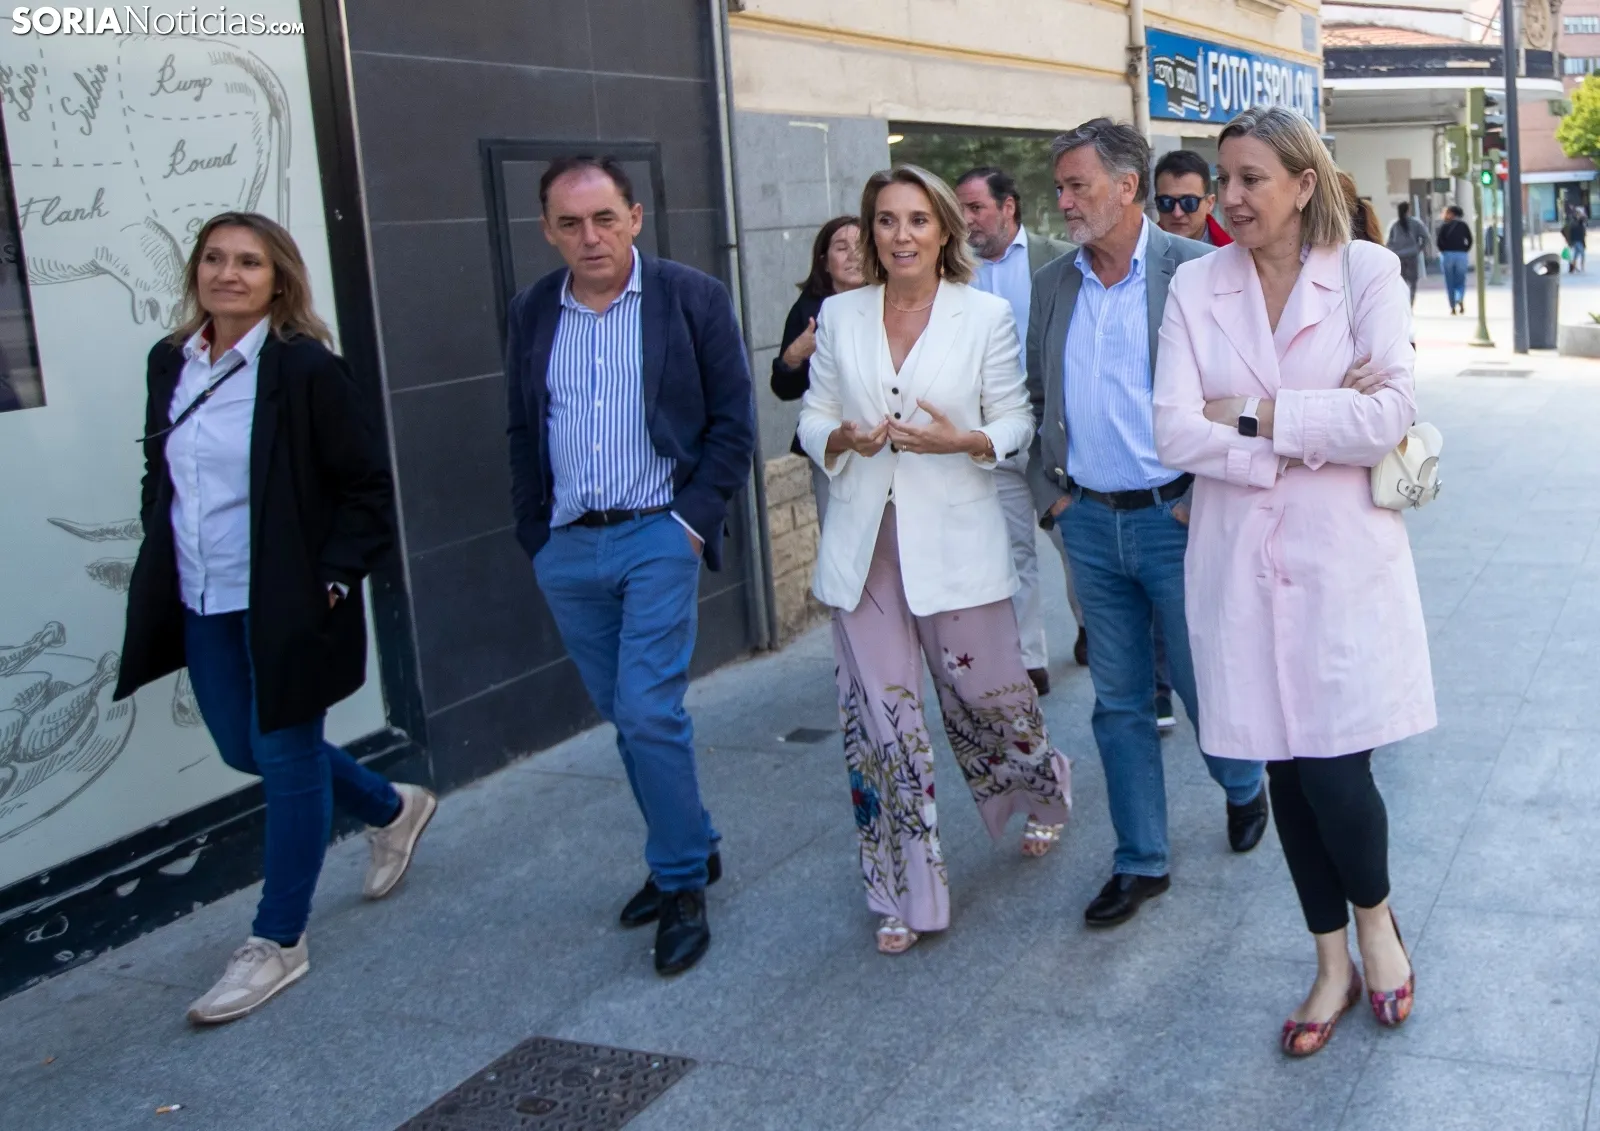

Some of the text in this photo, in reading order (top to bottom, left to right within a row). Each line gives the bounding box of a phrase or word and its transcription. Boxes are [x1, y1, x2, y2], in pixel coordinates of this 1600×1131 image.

[150, 54, 213, 102] Rump
[1154, 63, 1175, 89] FOTO
[1207, 51, 1314, 119] FOTO ESPOLON
[162, 139, 237, 178] Round
[19, 187, 110, 230] Flank
